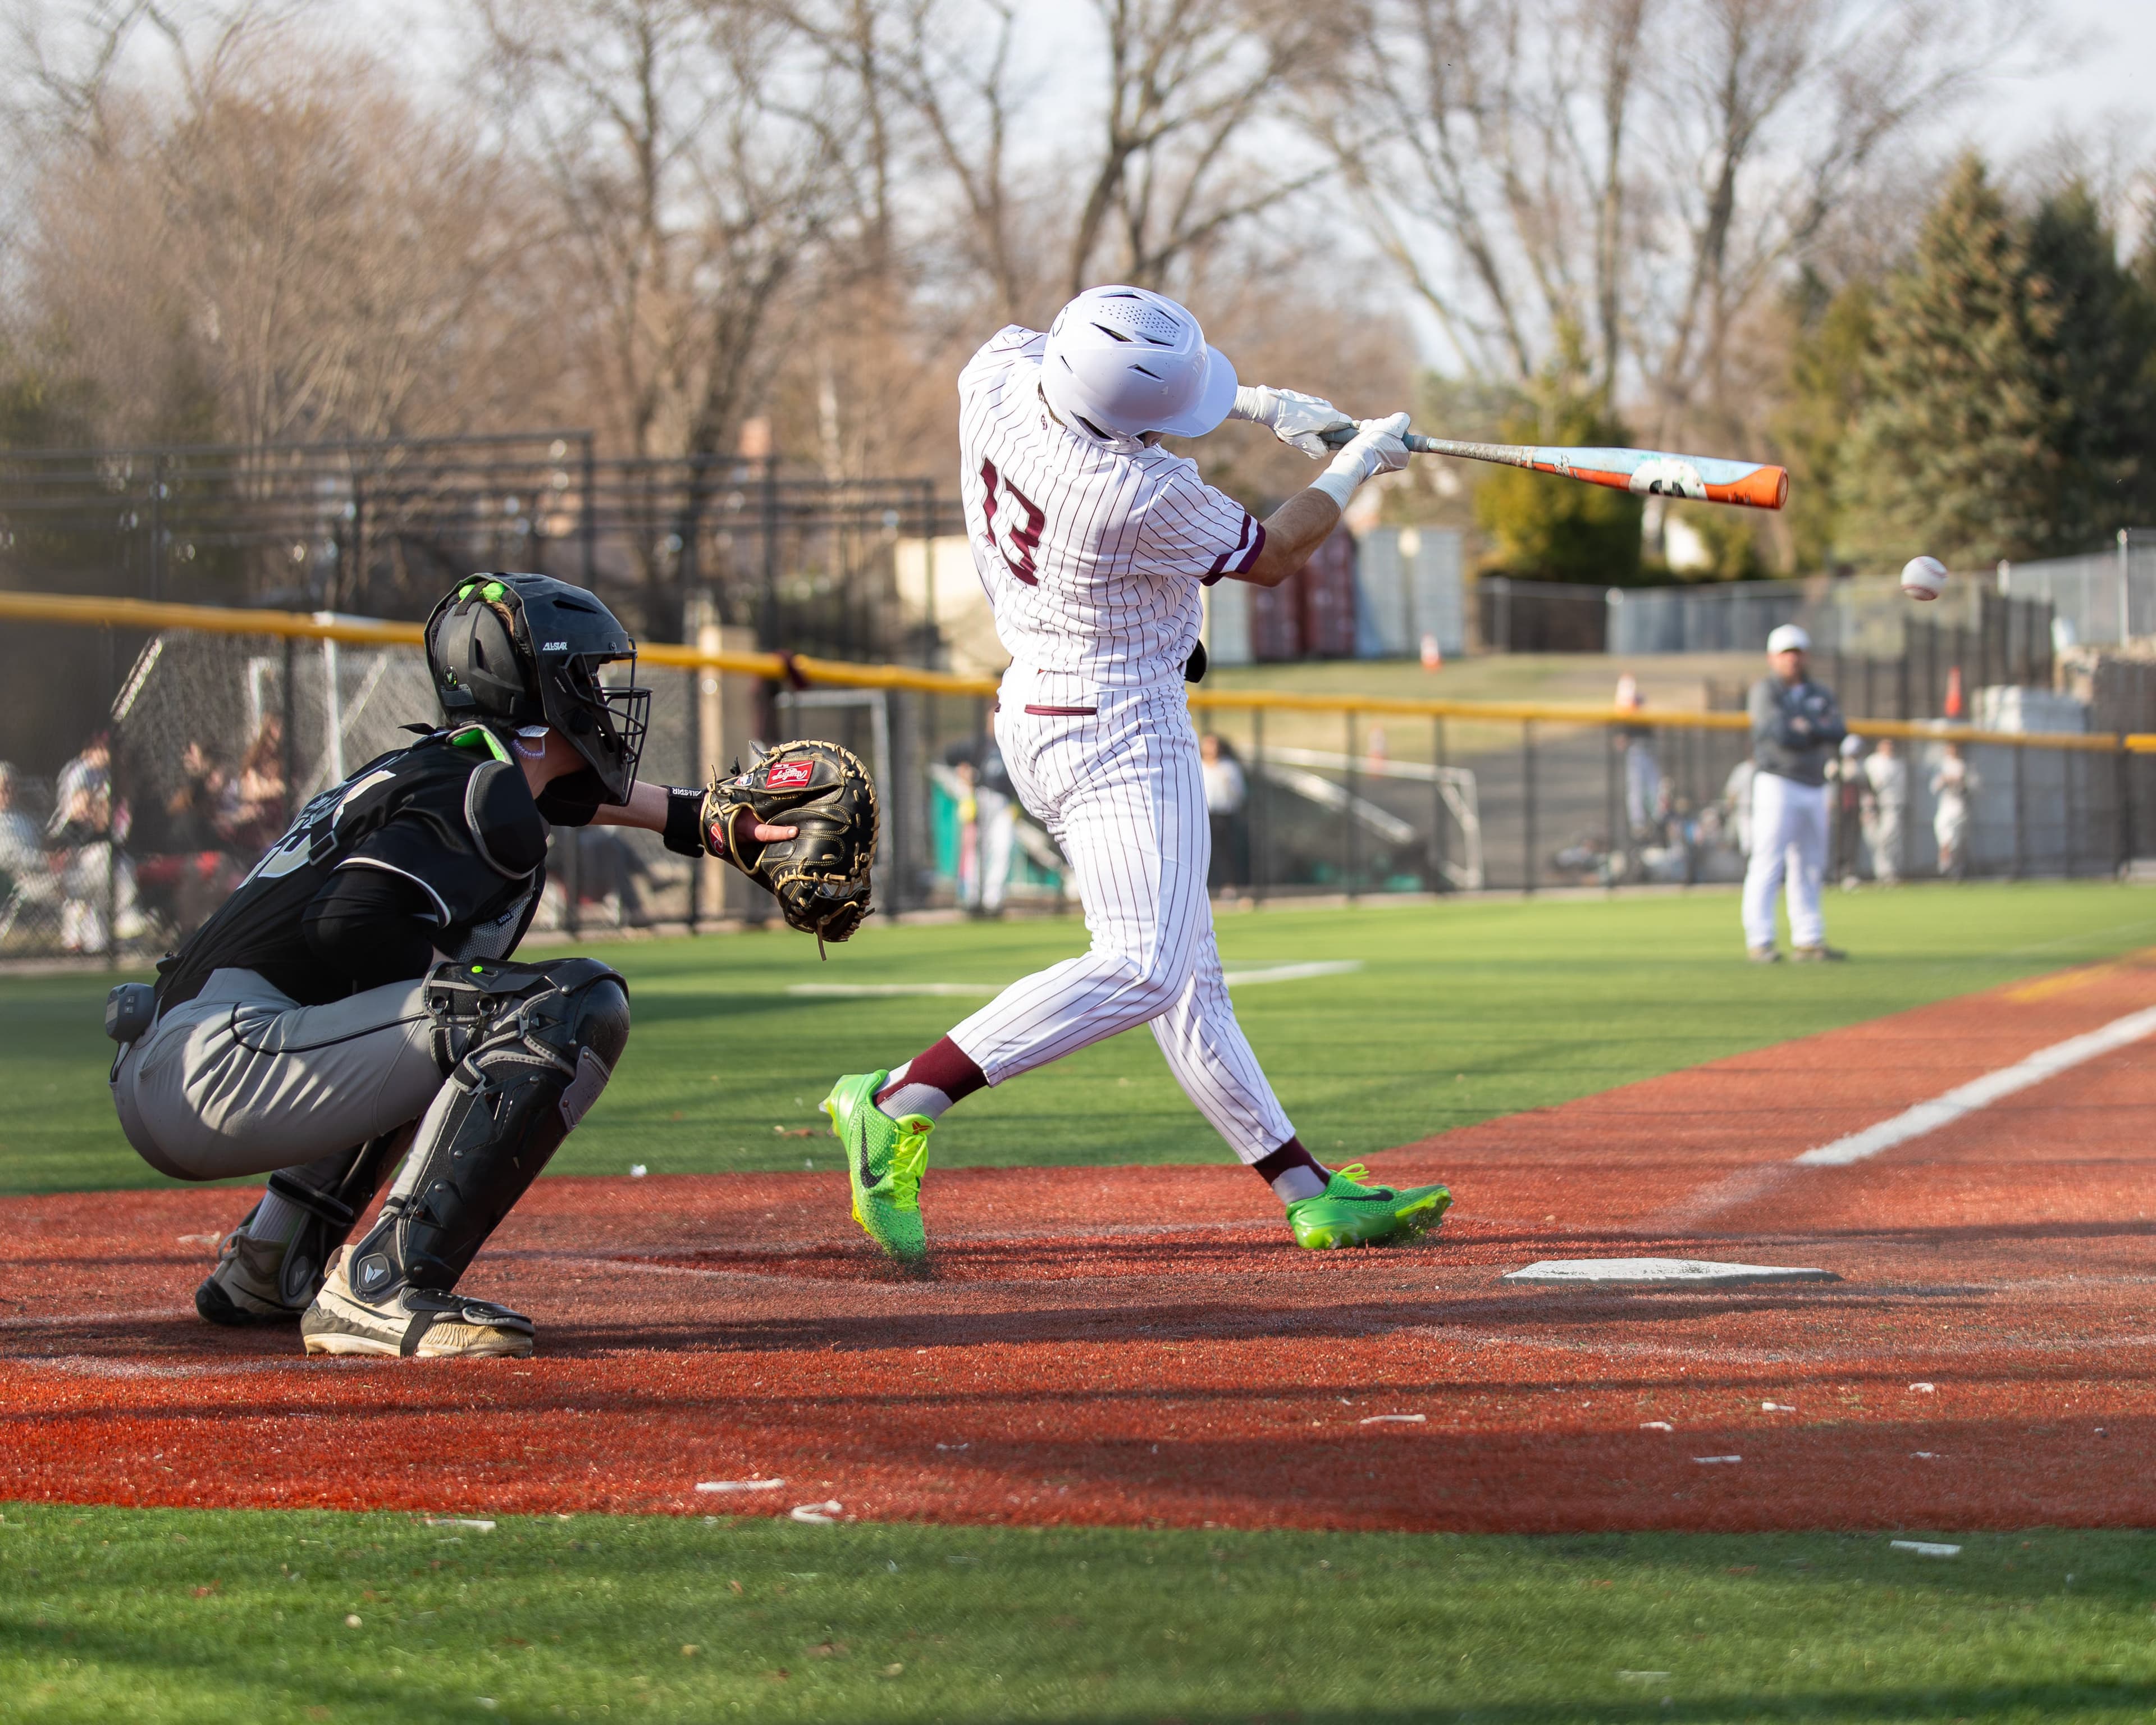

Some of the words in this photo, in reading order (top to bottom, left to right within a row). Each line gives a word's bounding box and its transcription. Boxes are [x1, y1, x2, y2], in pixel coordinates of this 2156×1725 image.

[980, 455, 1046, 587] 13
[542, 642, 567, 651] ALL-STAR
[771, 768, 808, 781] Rawlings
[672, 787, 702, 797] ALL-STAR
